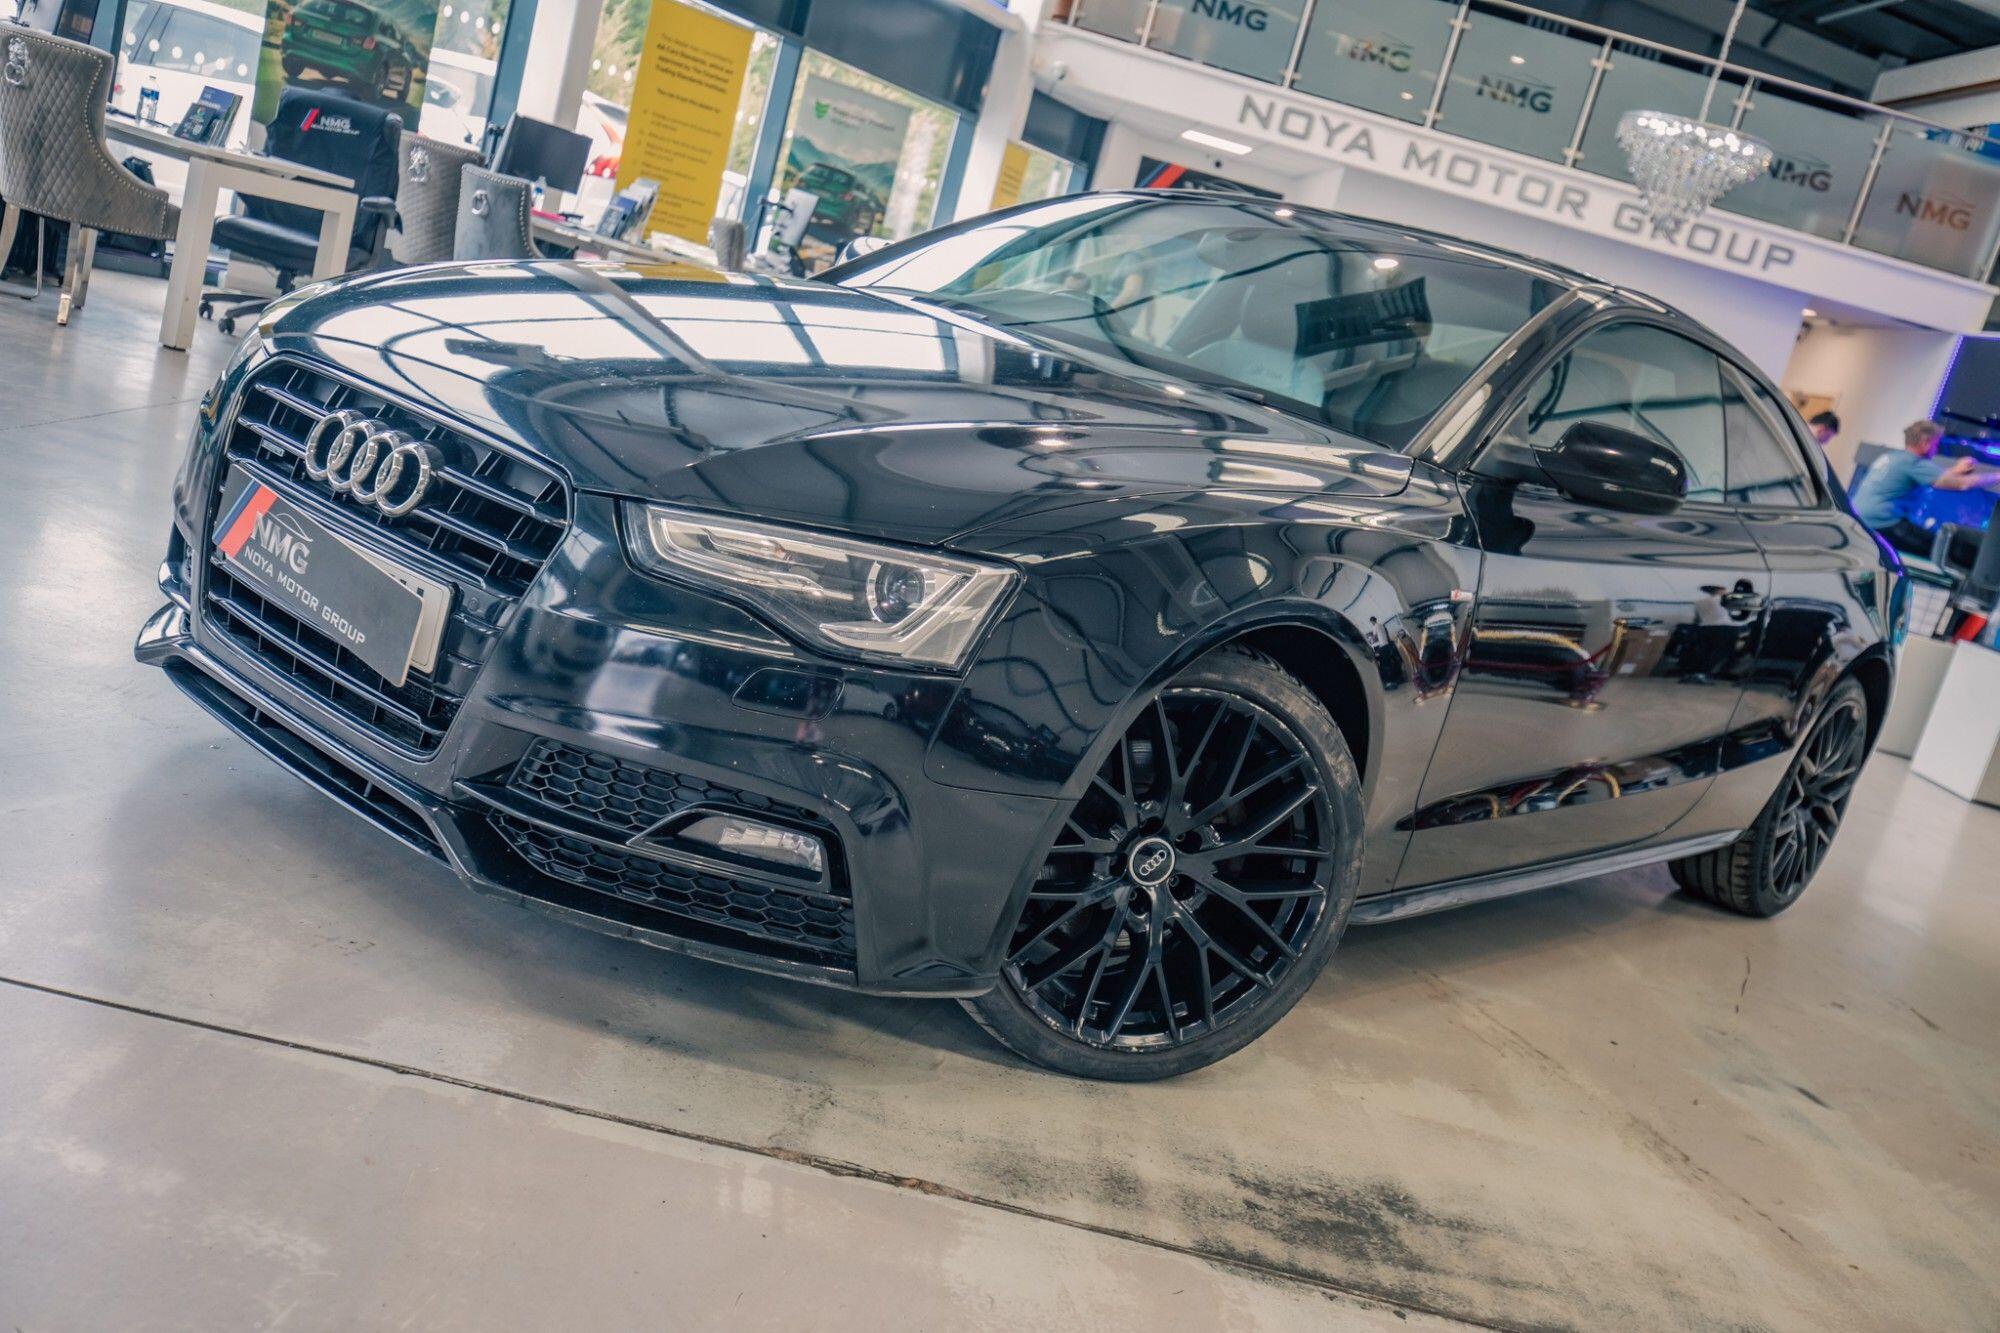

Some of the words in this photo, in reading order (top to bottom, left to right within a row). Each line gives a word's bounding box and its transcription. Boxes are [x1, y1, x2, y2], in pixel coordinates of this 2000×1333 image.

[1191, 0, 1268, 31] NMG
[1476, 74, 1553, 113] NMG
[1238, 94, 1377, 161] NOYA
[1402, 141, 1591, 220] MOTOR
[1613, 202, 1795, 272] GROUP
[1767, 158, 1834, 193] NMG
[1896, 191, 1972, 231] NMG
[250, 511, 311, 575] NMG
[244, 545, 275, 578] NOYA
[276, 570, 319, 612] MOTOR
[321, 604, 366, 645] GROUP
